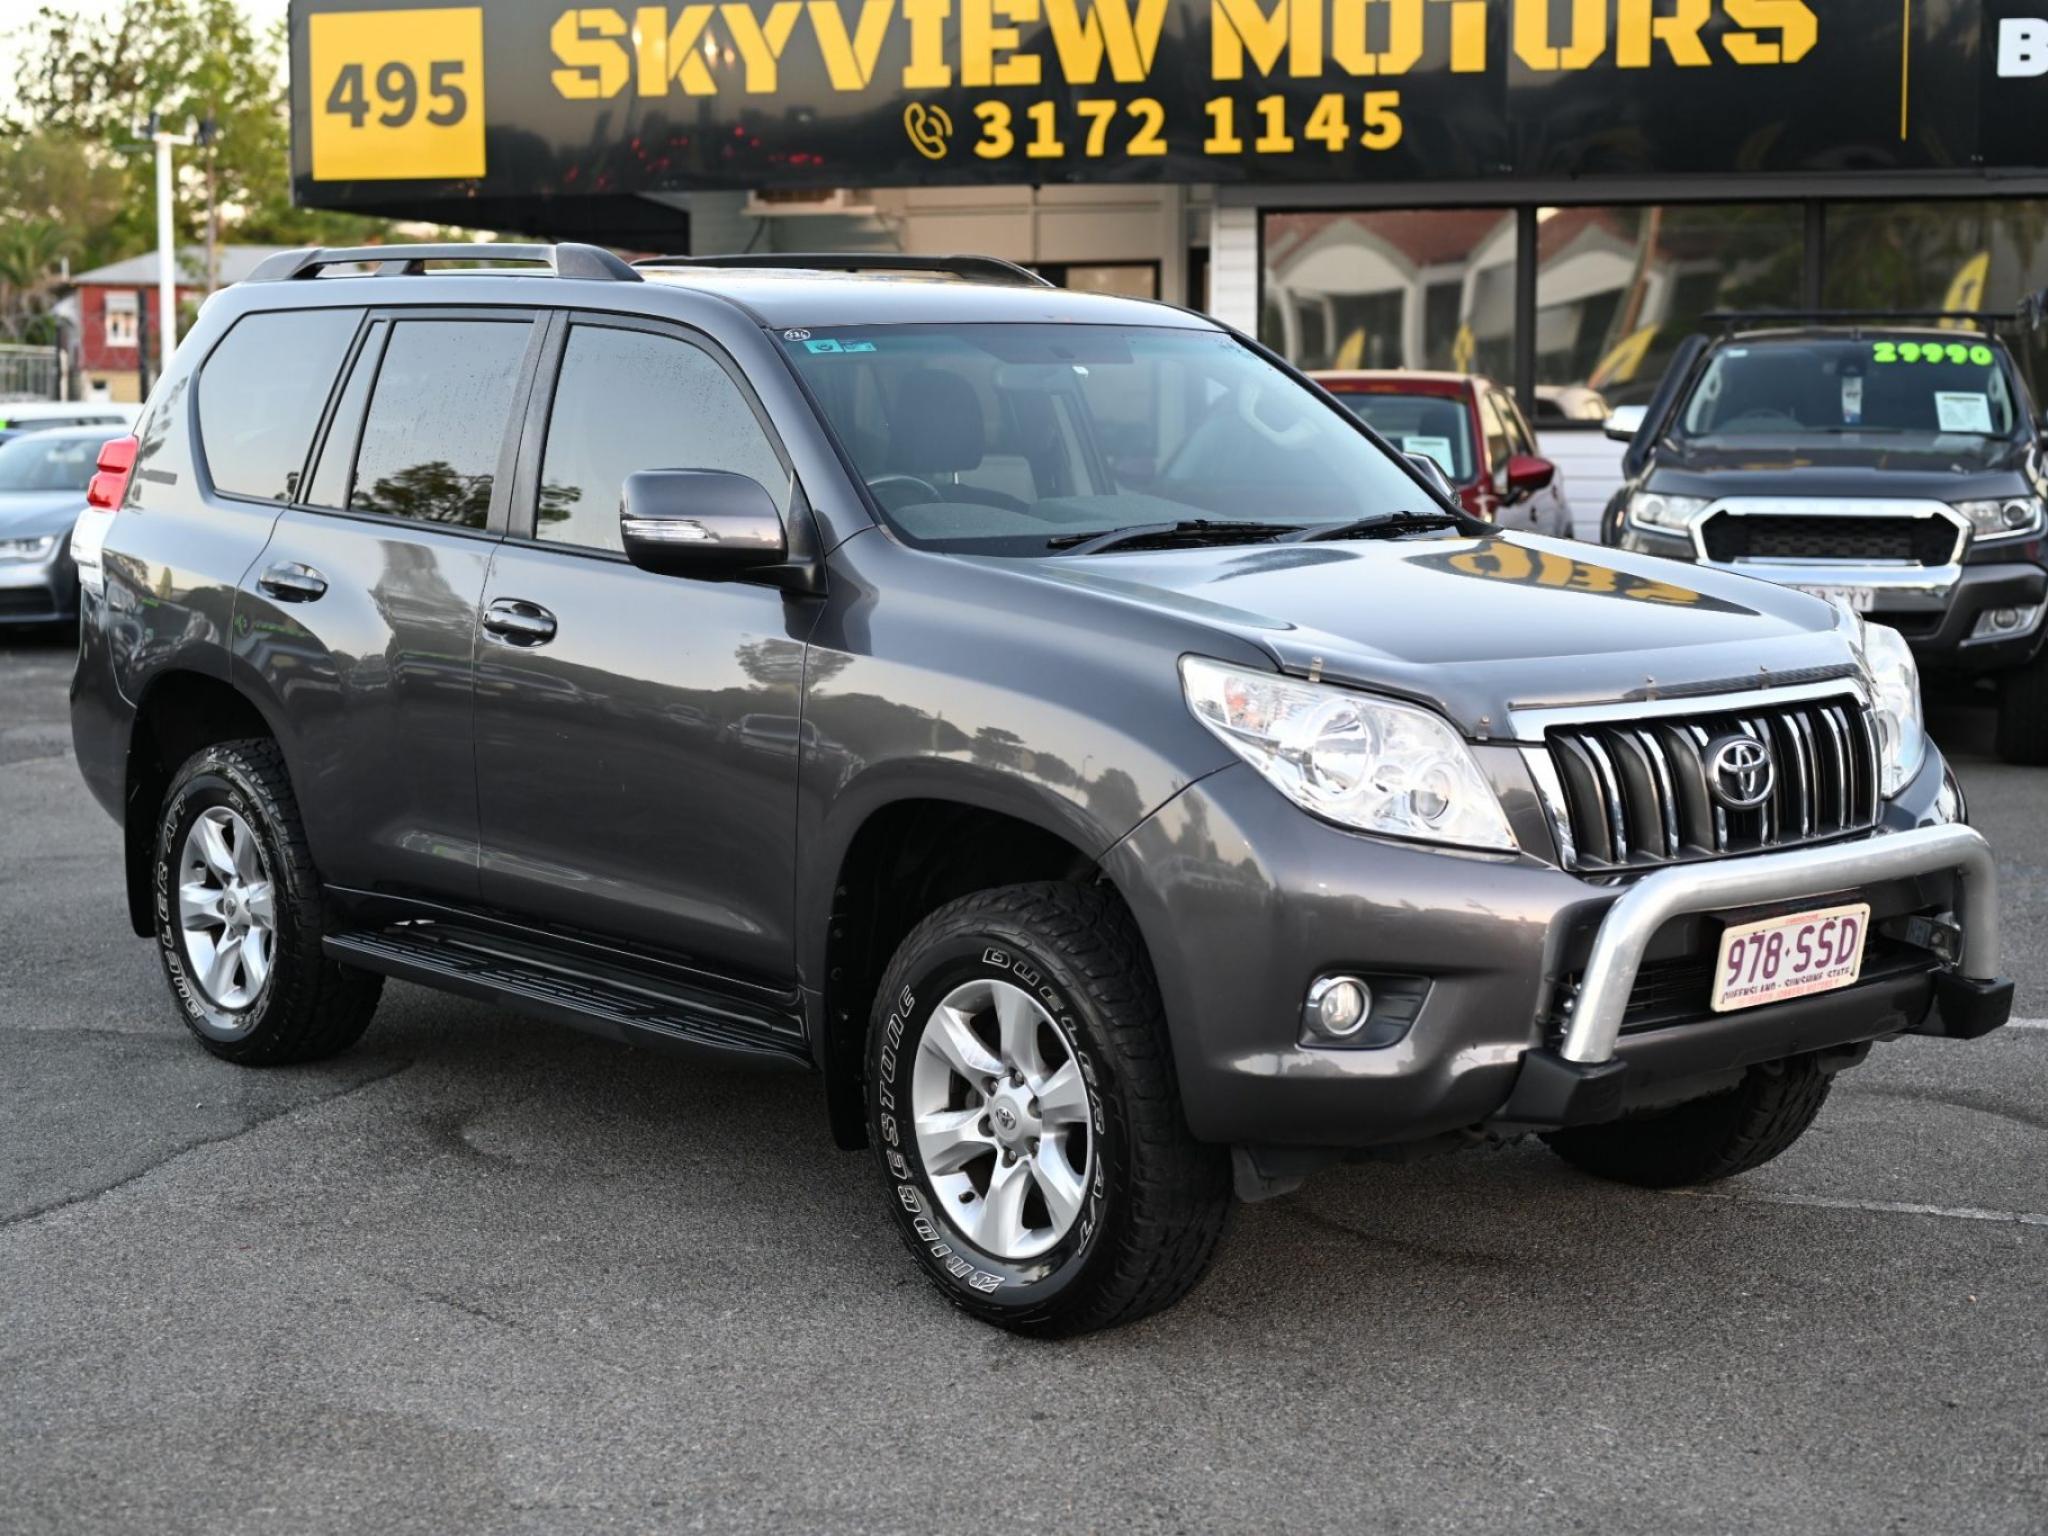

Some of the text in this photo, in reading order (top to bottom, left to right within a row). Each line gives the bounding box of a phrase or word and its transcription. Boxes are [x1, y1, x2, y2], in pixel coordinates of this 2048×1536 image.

[550, 0, 1818, 99] SKYVIEW MOTORS
[325, 60, 468, 128] 495
[973, 90, 1403, 158] 3172 1145
[1873, 341, 1994, 366] 29990
[879, 984, 1006, 1294] BRIDGESTONE
